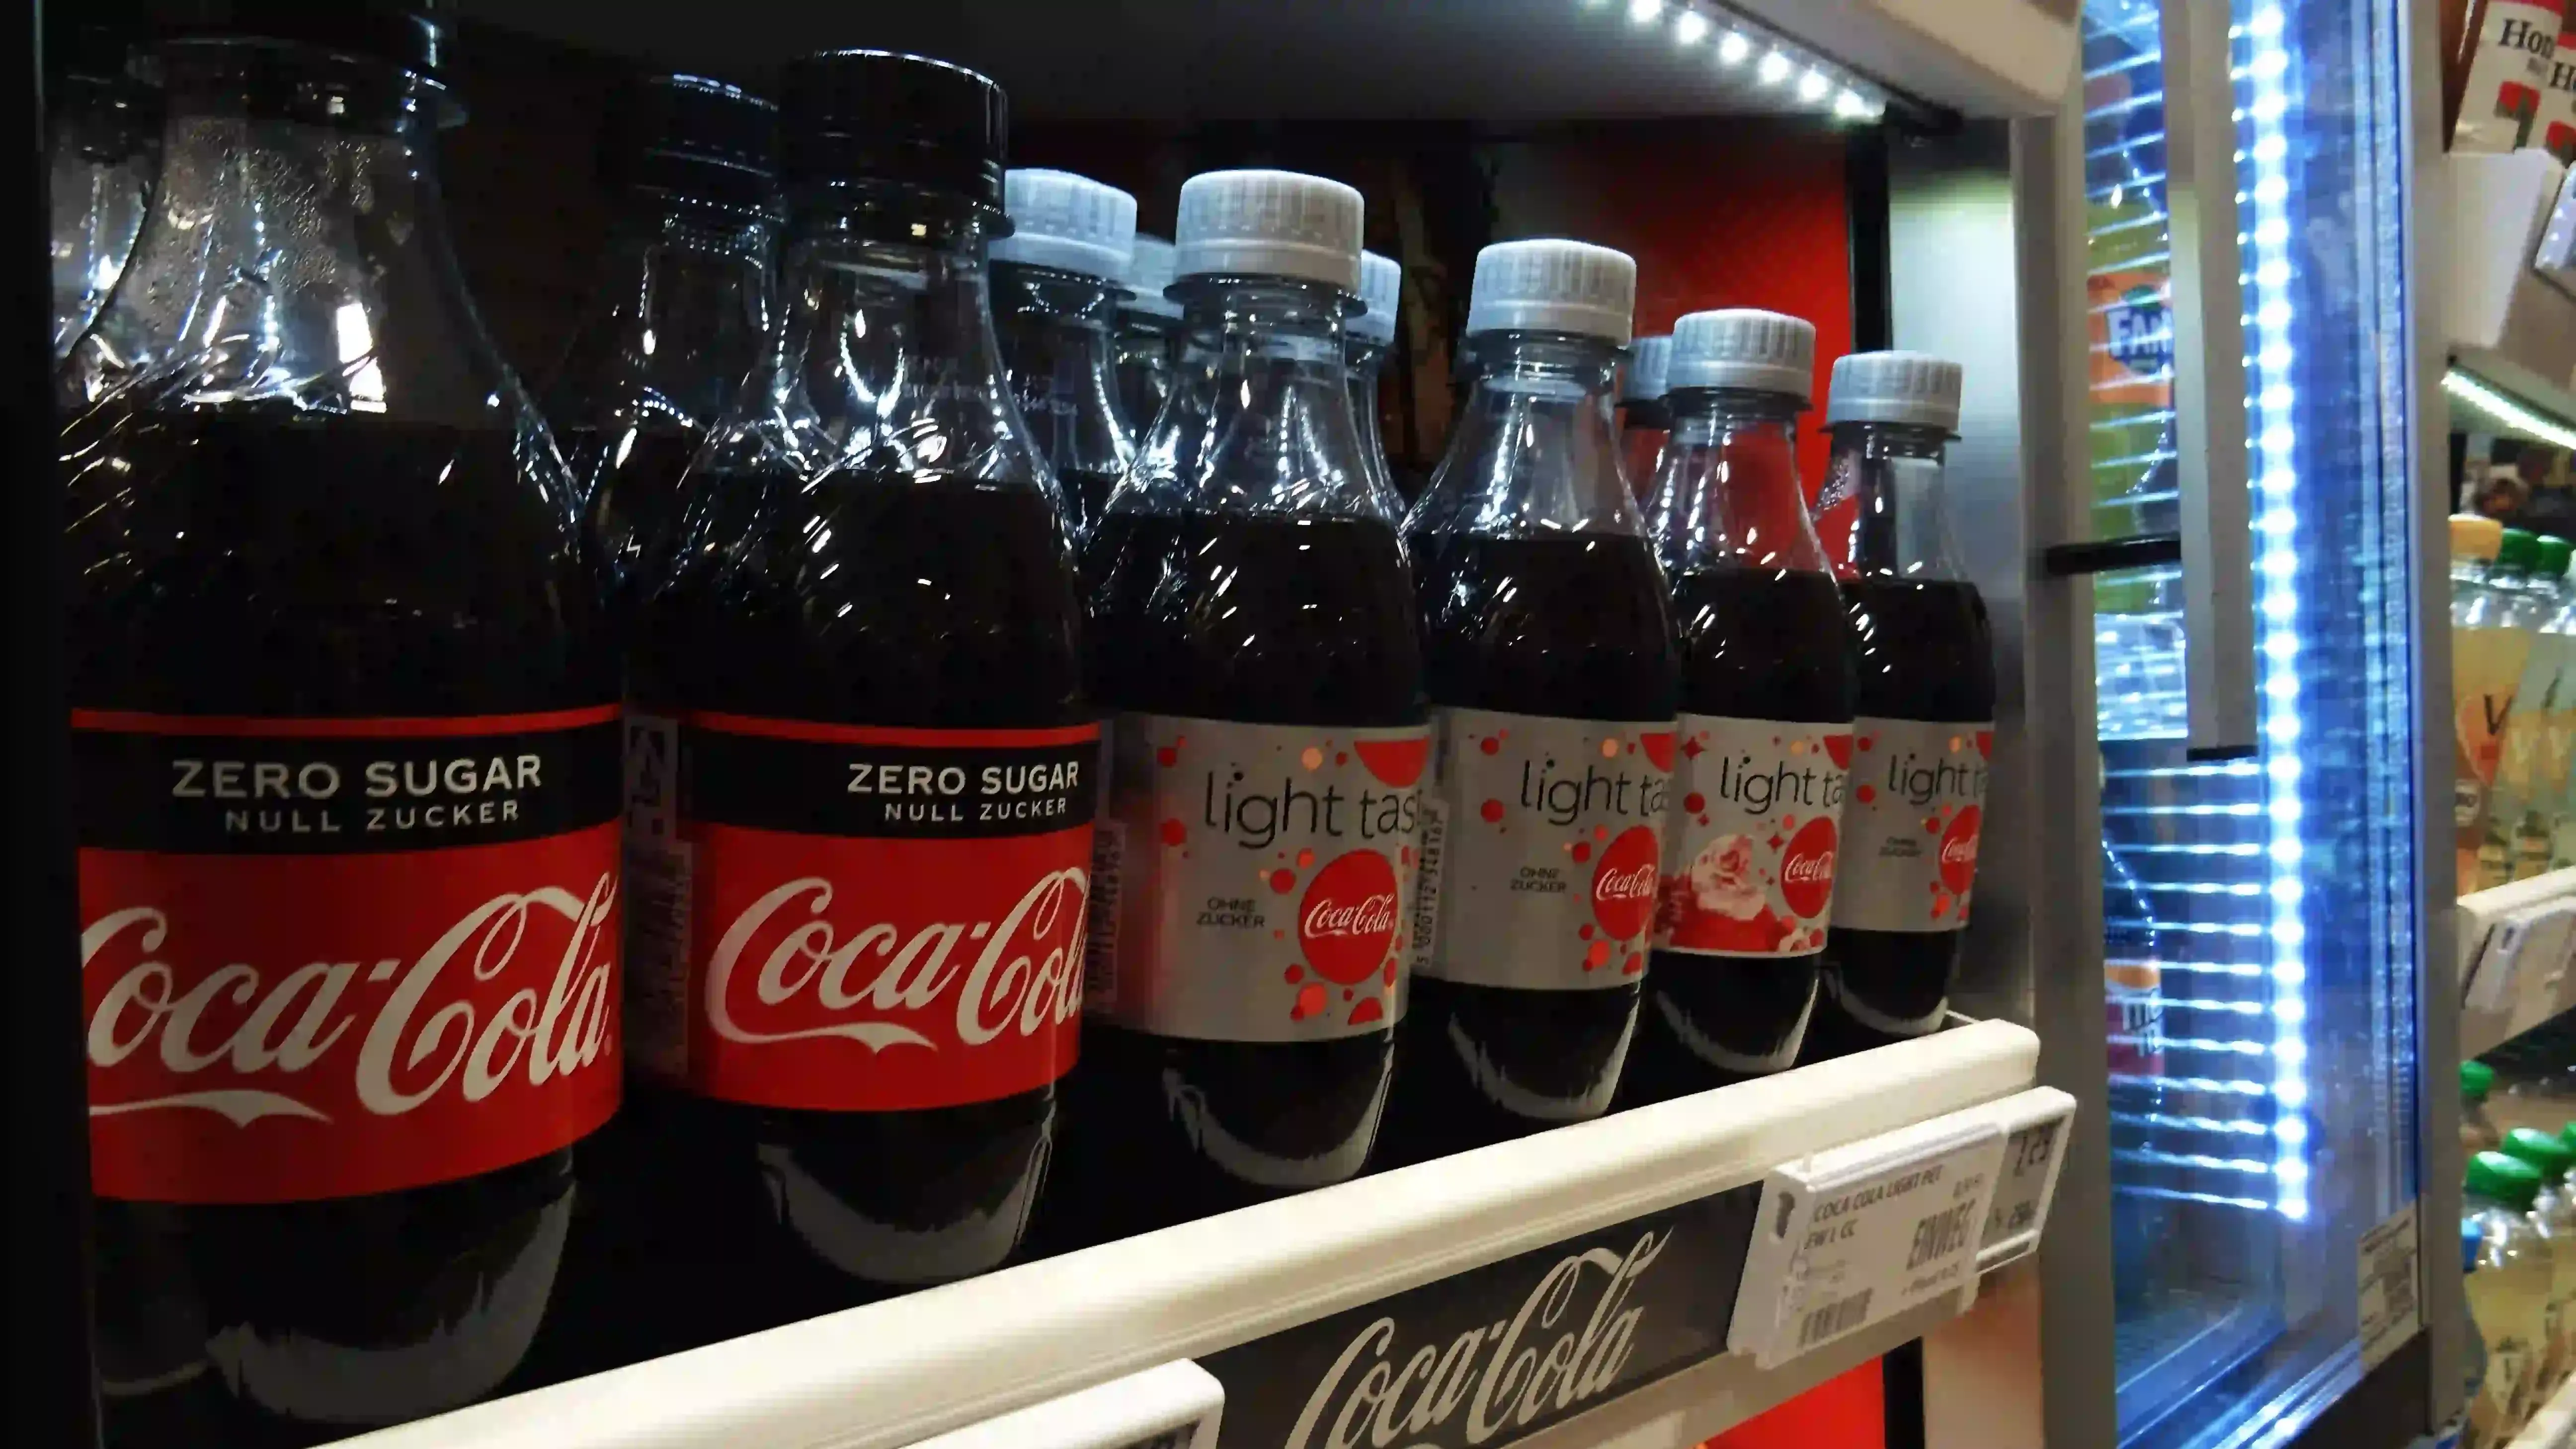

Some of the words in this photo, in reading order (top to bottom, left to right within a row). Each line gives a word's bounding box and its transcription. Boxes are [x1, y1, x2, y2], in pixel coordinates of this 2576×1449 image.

[171, 761, 340, 799] ZERO
[365, 754, 541, 797] SUGAR
[847, 763, 966, 795] ZERO
[980, 761, 1079, 795] SUGAR
[1521, 753, 1632, 826] light
[1719, 750, 1817, 815] light
[1888, 753, 1968, 806] light
[225, 808, 341, 833] NULL
[366, 799, 520, 831] ZUCKER
[884, 803, 964, 822] NULL
[979, 797, 1066, 821] ZUCKER
[1205, 763, 1345, 850] light
[1196, 912, 1265, 928] ZUCKER
[1207, 896, 1256, 912] OHNE
[1304, 893, 1395, 939] Coca-Cola
